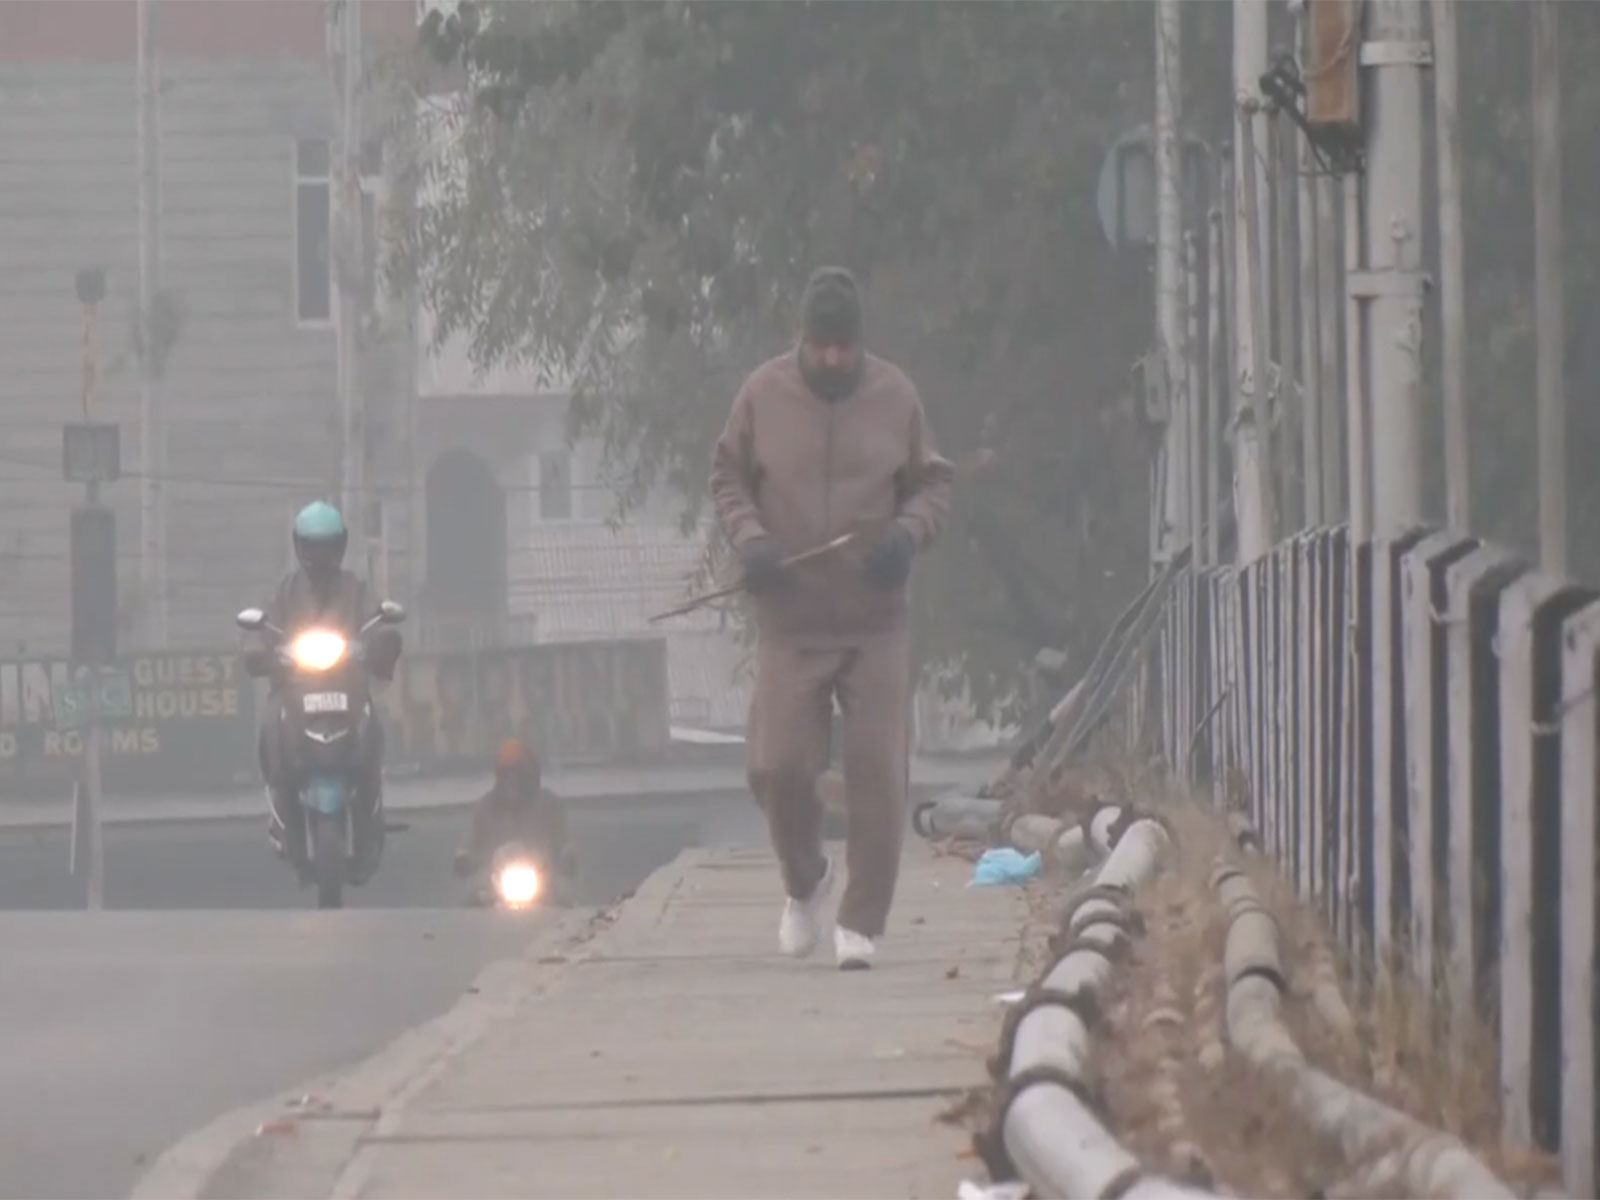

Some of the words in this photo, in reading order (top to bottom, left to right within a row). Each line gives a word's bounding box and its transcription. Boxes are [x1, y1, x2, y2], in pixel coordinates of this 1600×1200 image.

[134, 656, 238, 686] GUEST
[136, 688, 239, 718] HOUSE
[44, 727, 159, 757] ROMS
